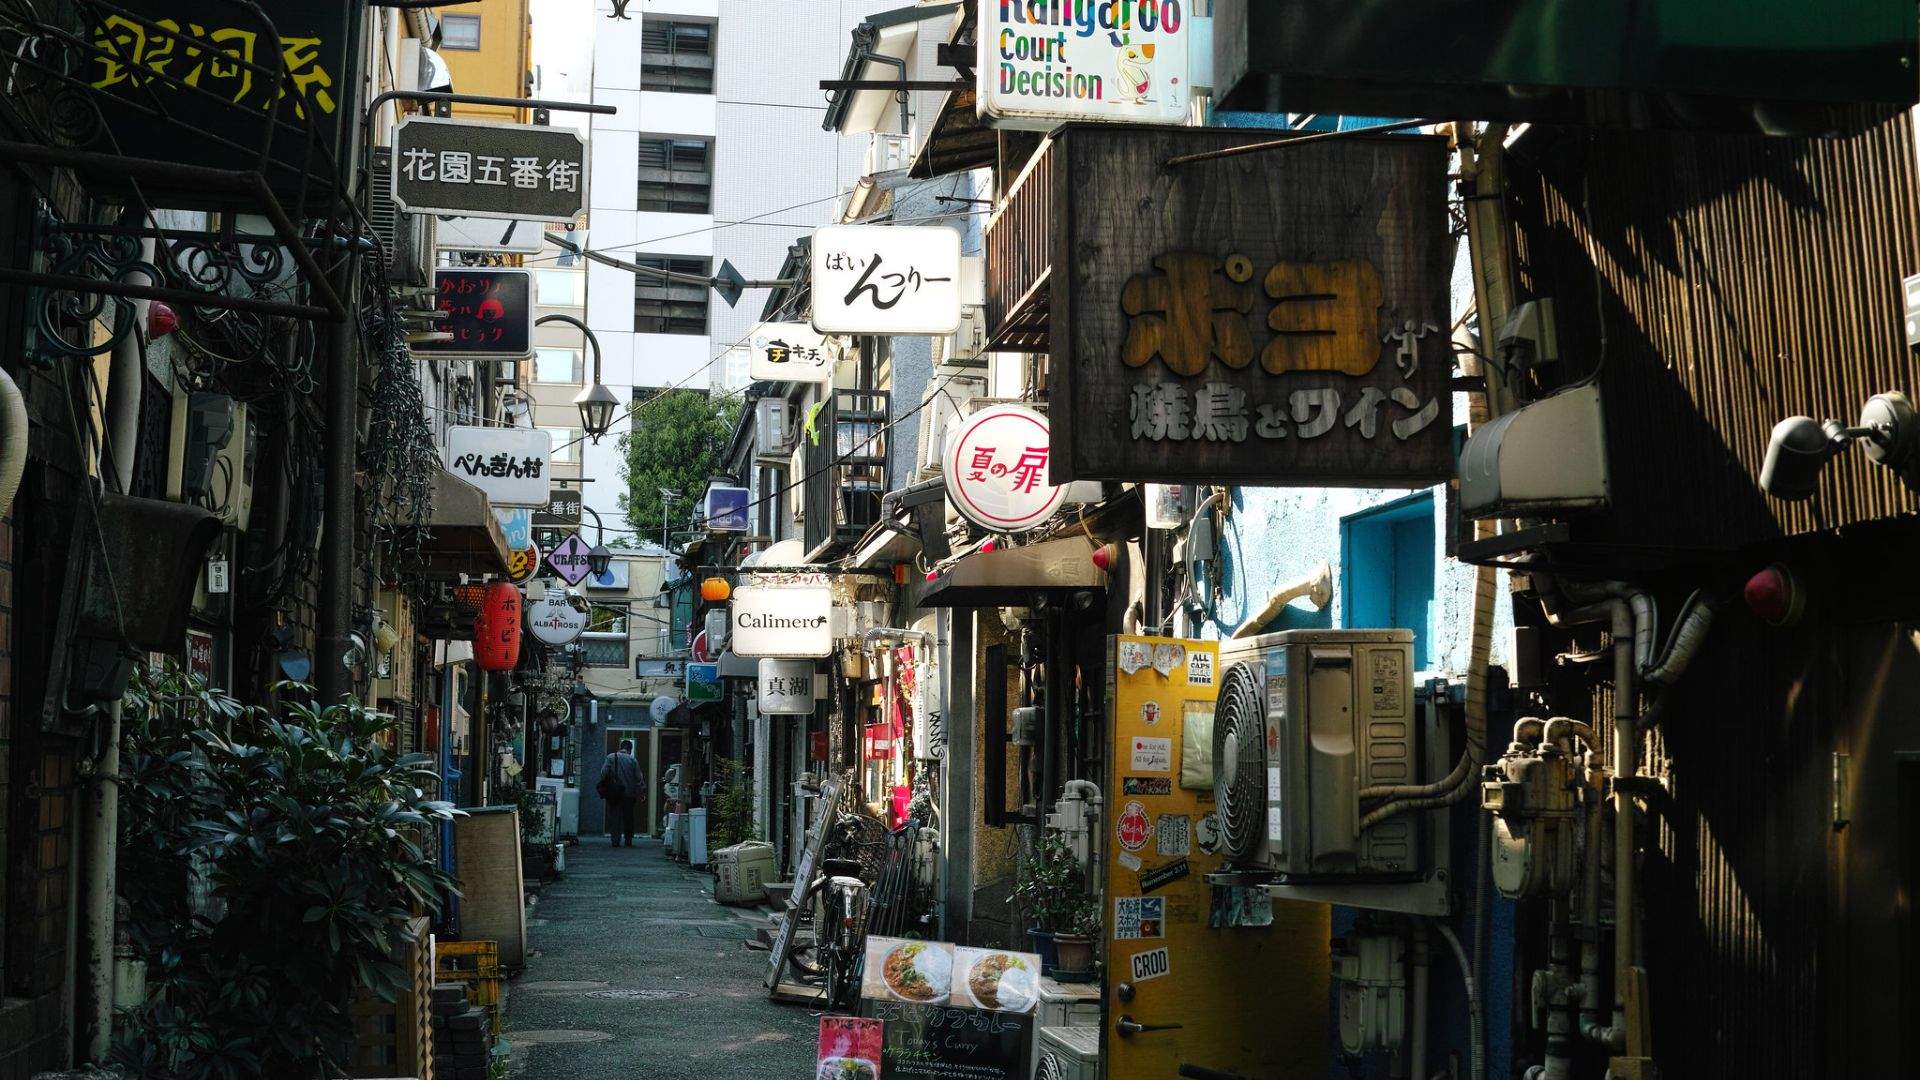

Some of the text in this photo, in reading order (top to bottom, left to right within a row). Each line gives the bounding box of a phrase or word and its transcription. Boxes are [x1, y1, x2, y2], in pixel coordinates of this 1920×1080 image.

[1000, 28, 1067, 63] Court
[91, 14, 336, 120] 銀河系
[1000, 62, 1103, 100] Decision
[402, 147, 580, 193] 花園五番街
[825, 252, 951, 310] ぱいんつりー
[1121, 251, 1384, 376] ポヨ
[1130, 382, 1439, 442] 焼鳥とワイン
[454, 452, 543, 479] ぺんぎん村
[966, 446, 1049, 493] 夏の扉
[540, 502, 580, 515] 番街
[501, 598, 515, 660] ホッピー
[534, 618, 579, 629] ALBATROSS
[738, 613, 822, 629] Calimero
[1193, 654, 1208, 662] ALL
[767, 676, 809, 697] 真湖
[1134, 951, 1167, 978] CROD
[895, 1030, 979, 1056] Today's Curry
